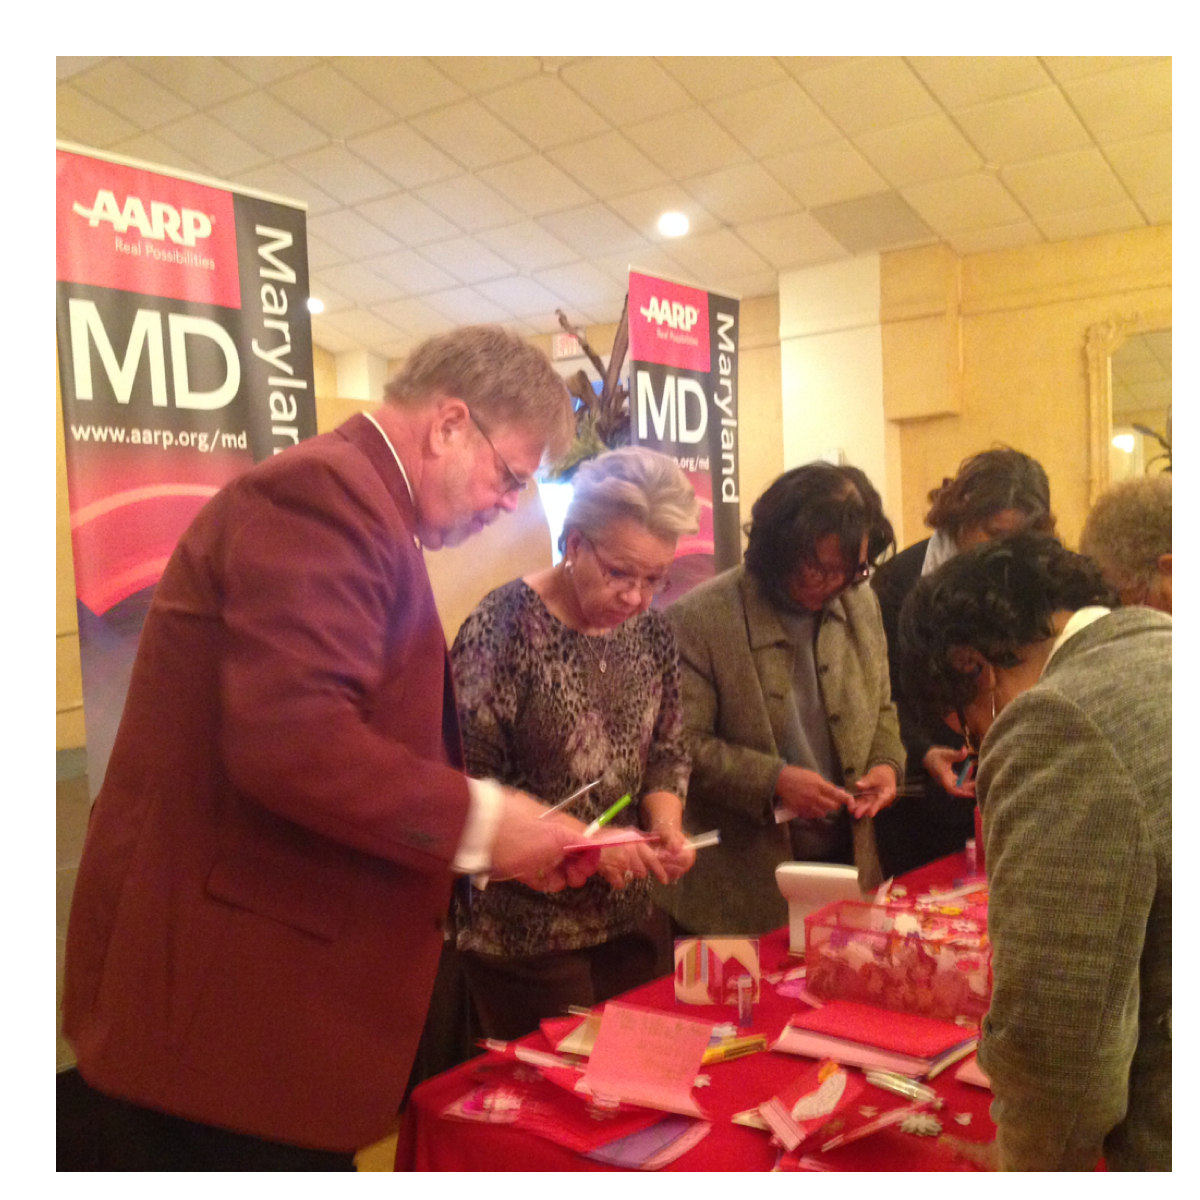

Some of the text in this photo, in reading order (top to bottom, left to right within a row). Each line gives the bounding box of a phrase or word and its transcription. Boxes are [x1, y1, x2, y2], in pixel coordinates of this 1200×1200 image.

[73, 188, 213, 247] AARP
[115, 237, 216, 270] Real Possibilities
[640, 295, 698, 332] AARP
[69, 298, 241, 410] MD
[637, 371, 708, 443] MD
[713, 312, 739, 503] Maryland
[71, 424, 248, 452] www.aarp.org/md
